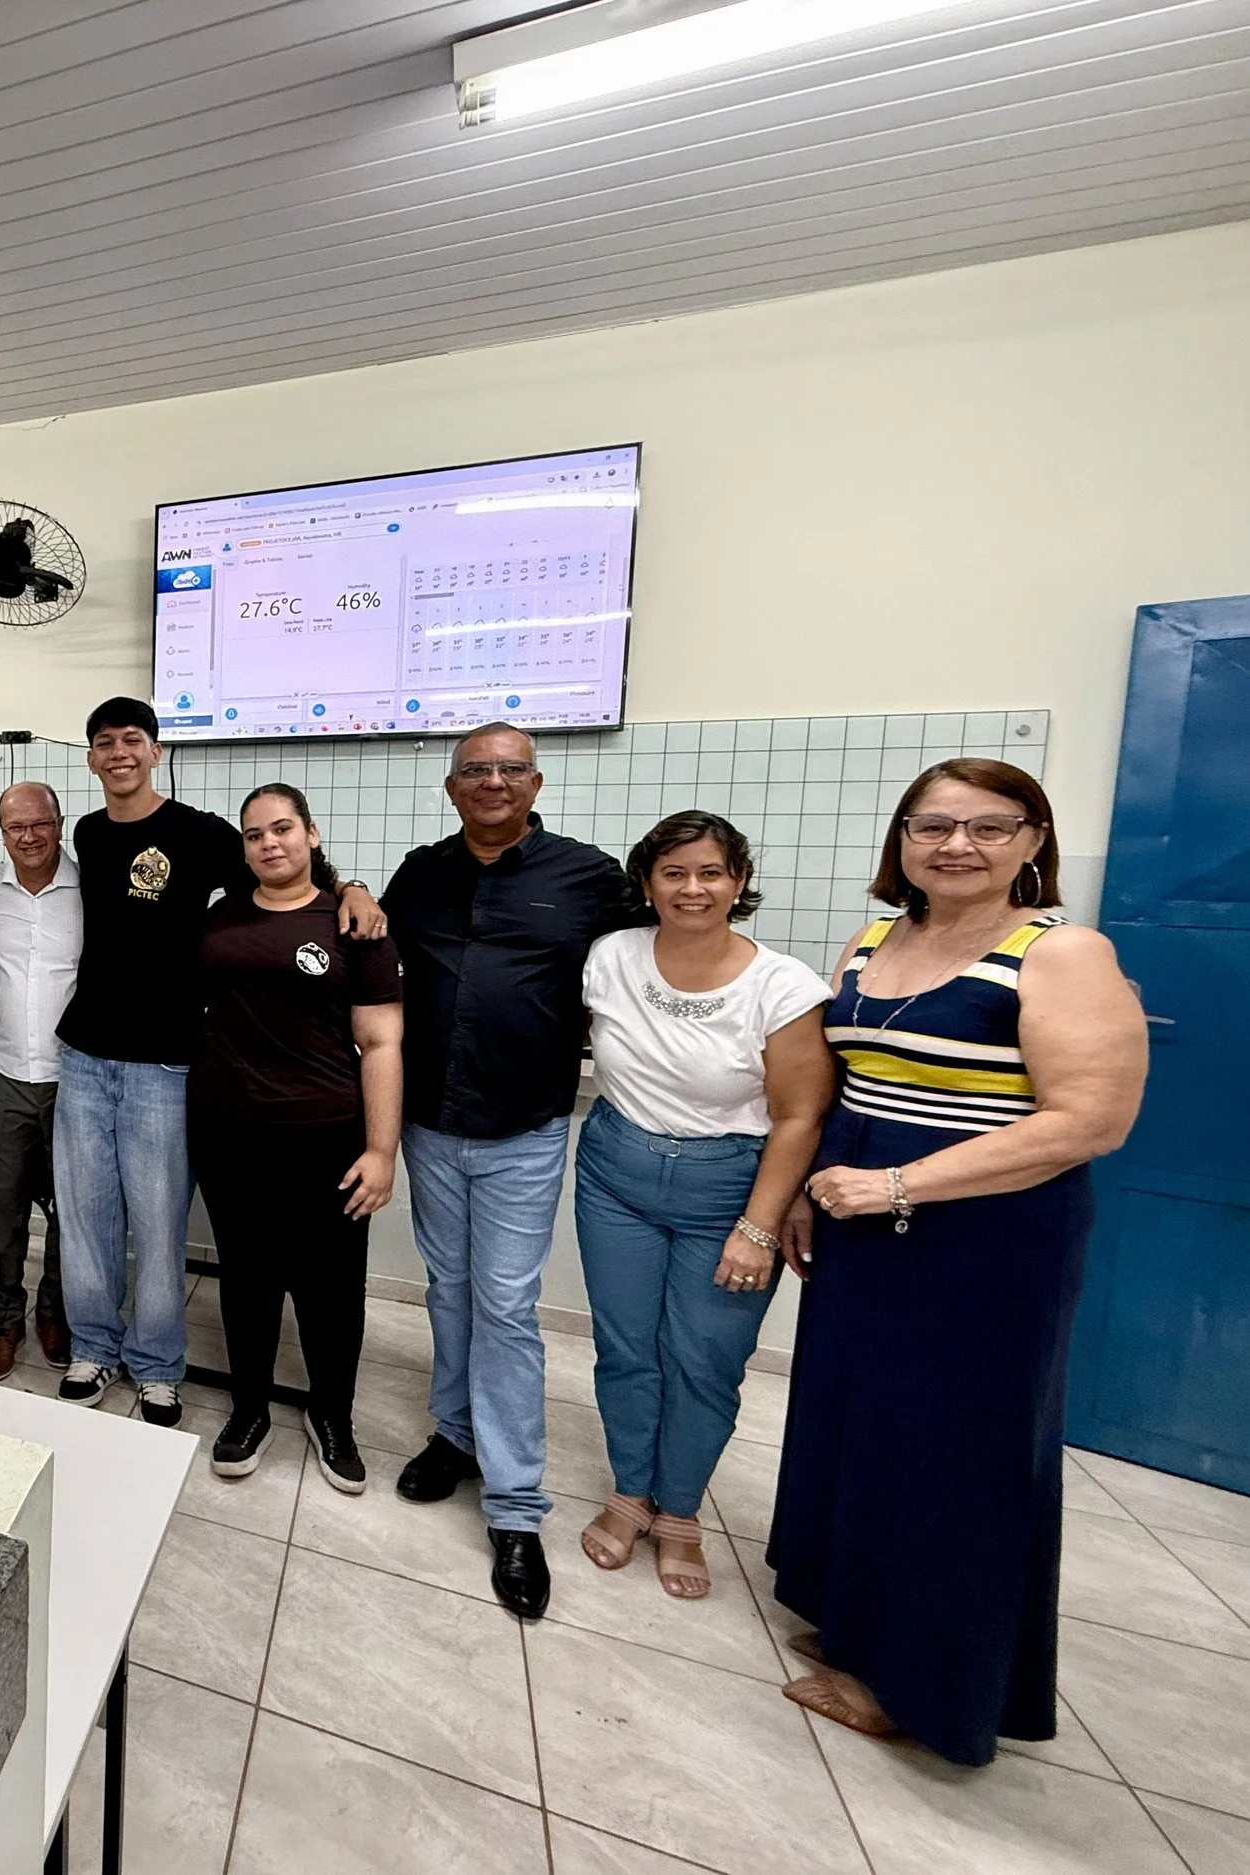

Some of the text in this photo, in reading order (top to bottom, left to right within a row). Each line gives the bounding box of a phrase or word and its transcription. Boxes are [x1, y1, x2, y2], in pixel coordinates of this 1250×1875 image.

[161, 549, 191, 562] AWN
[240, 597, 302, 619] 27.6°C
[336, 591, 381, 611] 46%
[127, 888, 160, 901] PICTEC
